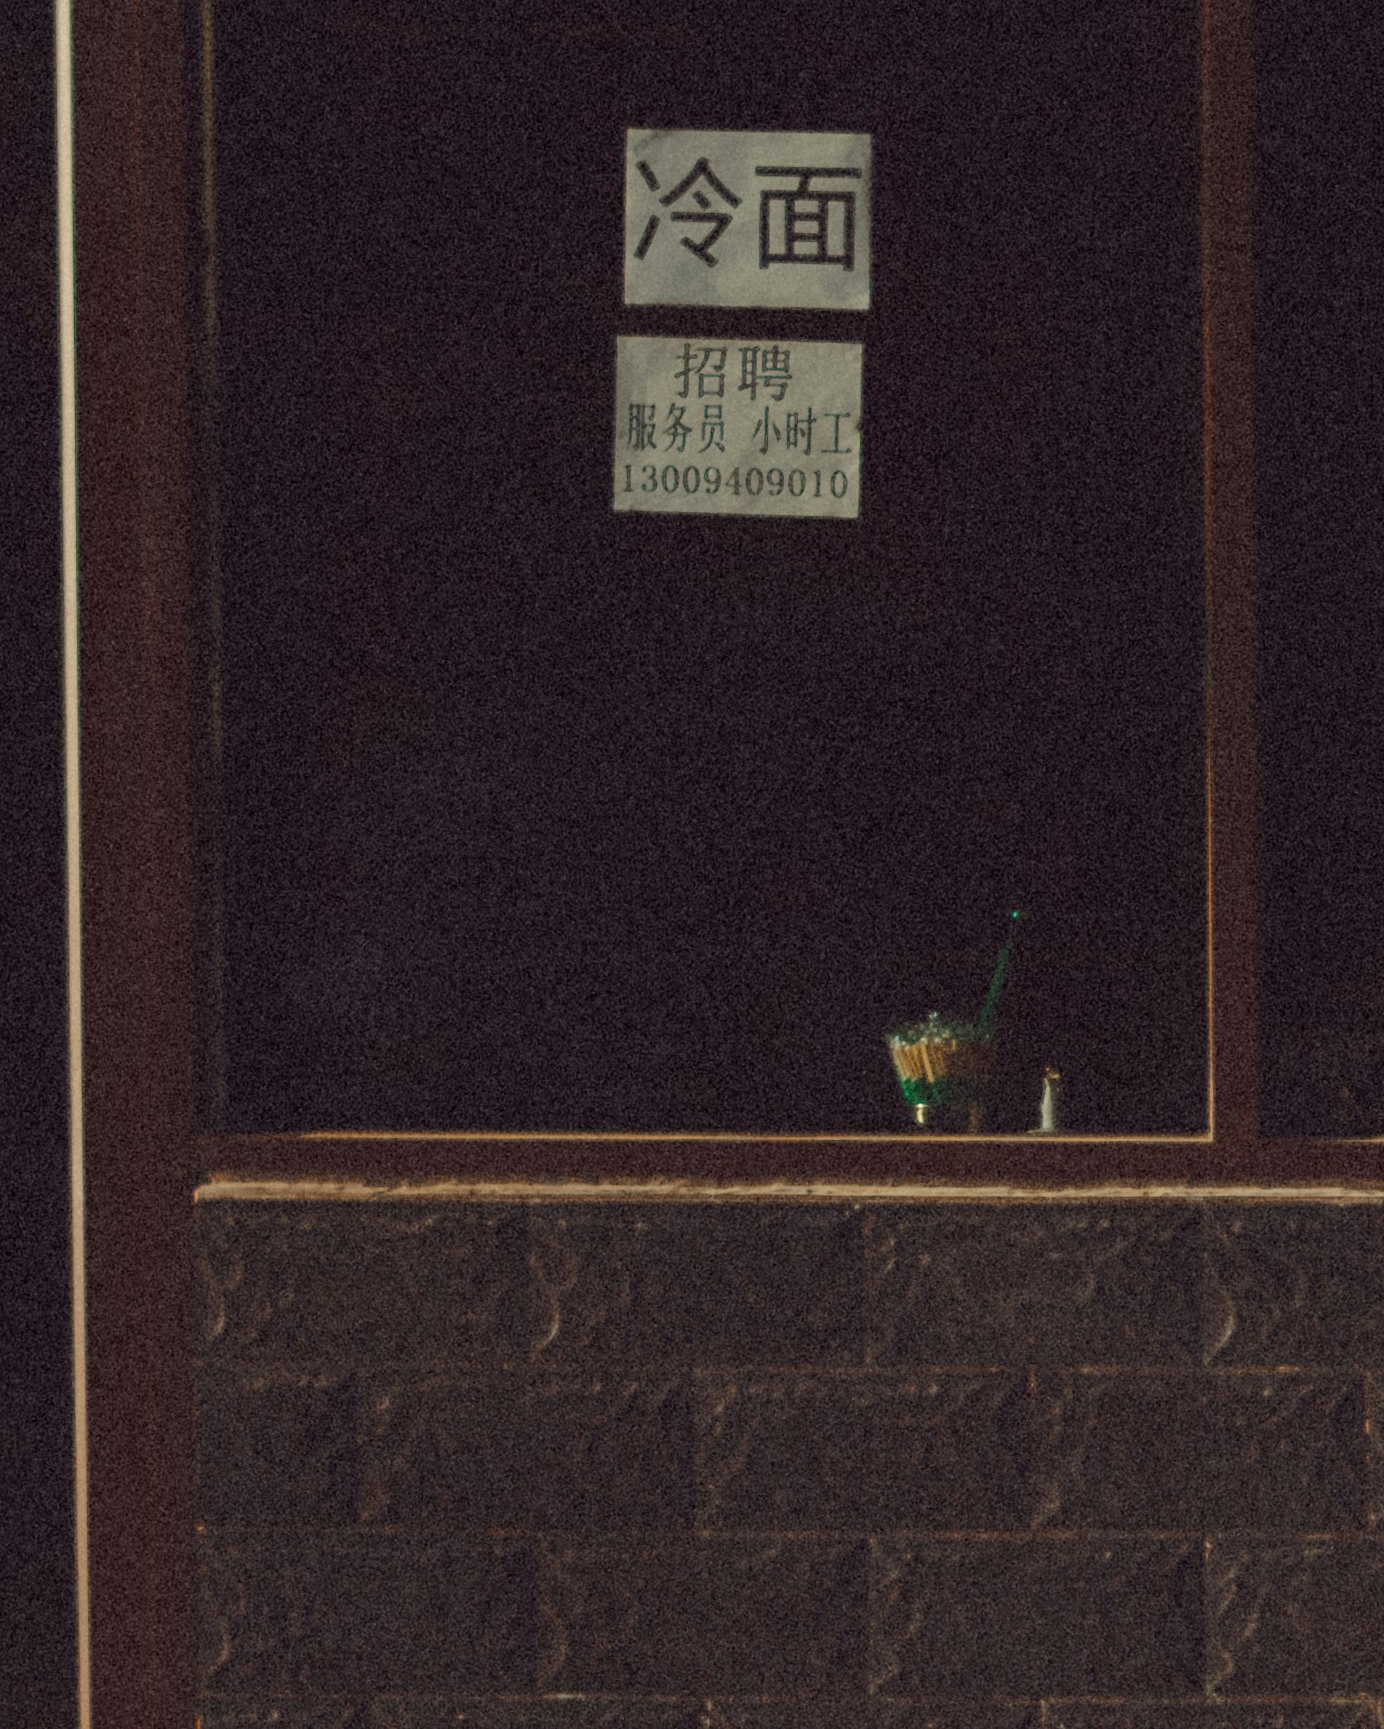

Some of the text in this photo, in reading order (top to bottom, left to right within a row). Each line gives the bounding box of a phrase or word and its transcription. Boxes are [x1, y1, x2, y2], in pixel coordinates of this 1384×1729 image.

[634, 156, 862, 272] 冷面
[673, 342, 793, 403] 招聘
[626, 402, 852, 456] 服务员 小时工
[621, 464, 849, 500] 13009409010
